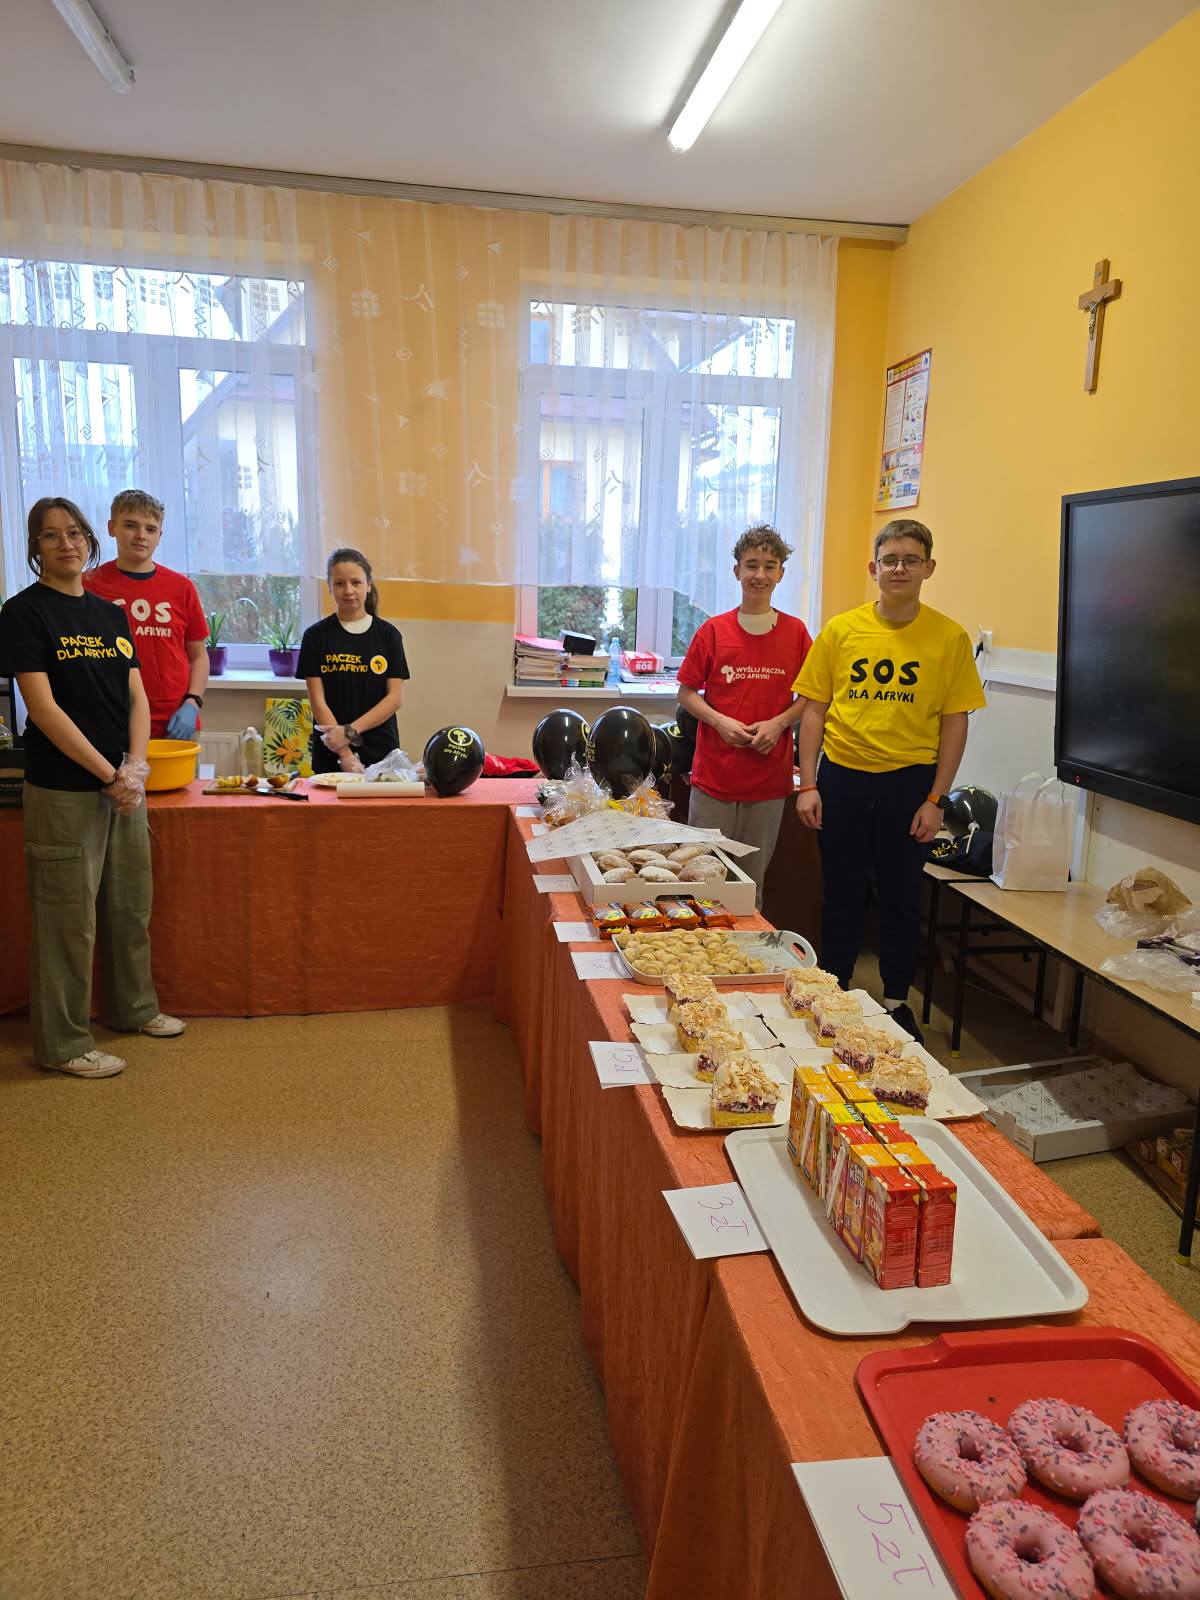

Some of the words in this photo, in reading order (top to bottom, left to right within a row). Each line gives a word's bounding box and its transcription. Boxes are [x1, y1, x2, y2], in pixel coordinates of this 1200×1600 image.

[135, 626, 172, 637] AFRYKI
[56, 648, 83, 661] DLA
[320, 664, 338, 673] DLA
[339, 664, 368, 673] AFRYKI
[850, 658, 920, 686] SOS
[848, 689, 869, 700] DLA
[873, 690, 915, 703] AFRYKI
